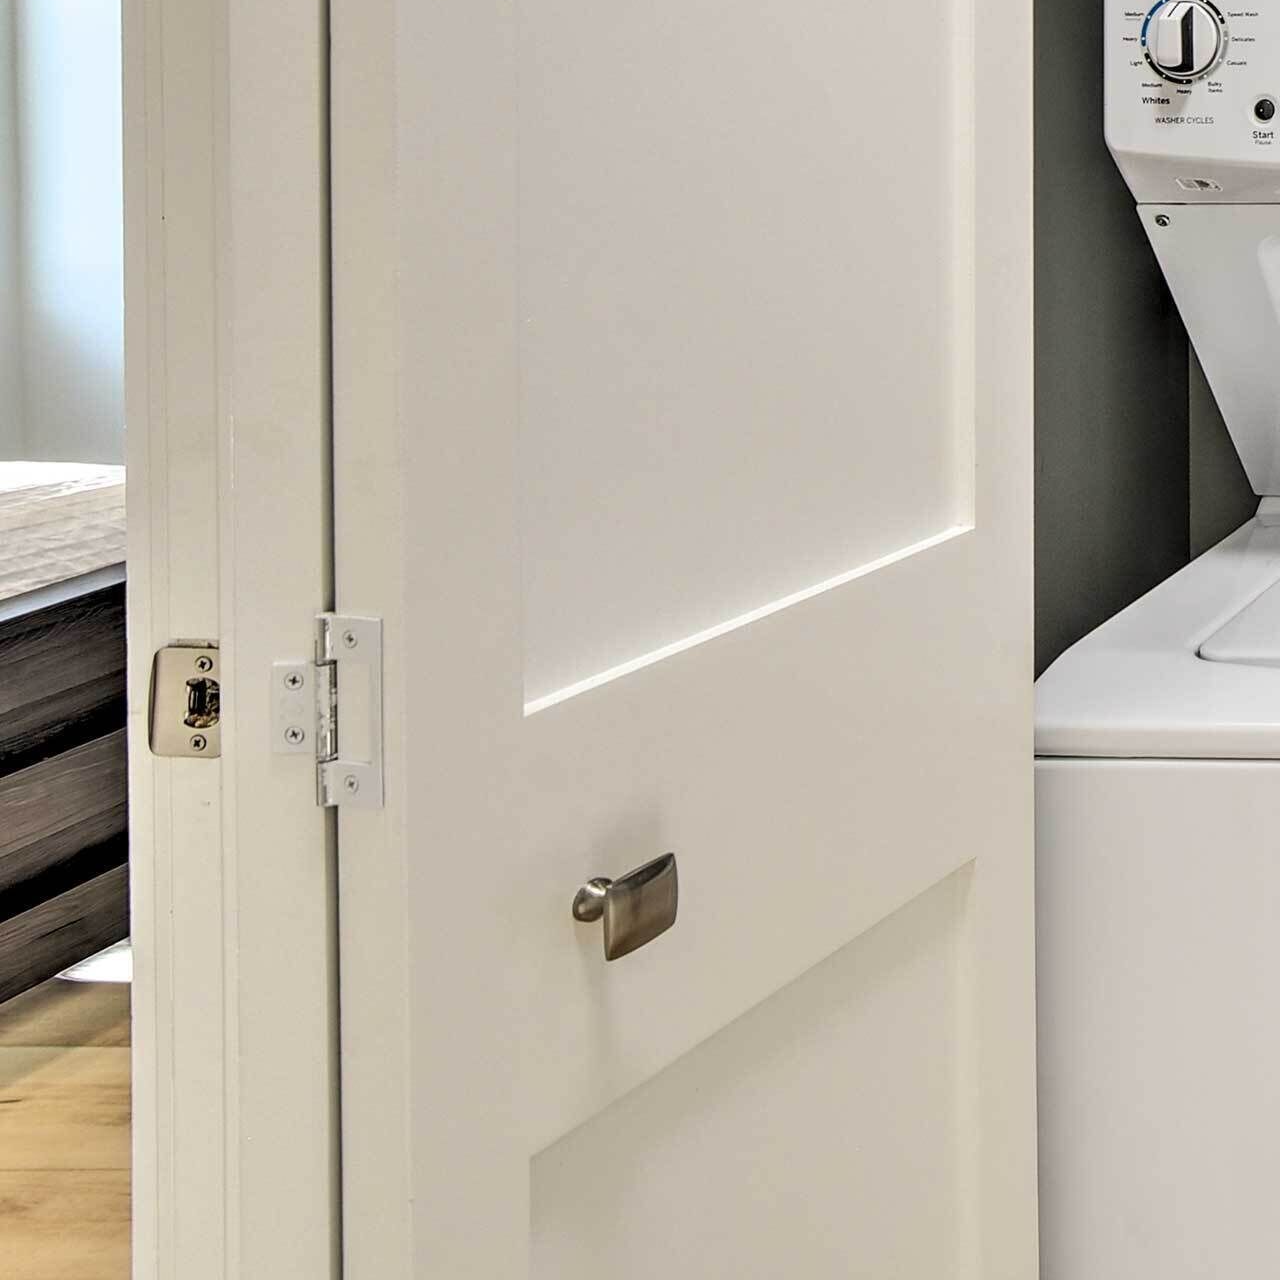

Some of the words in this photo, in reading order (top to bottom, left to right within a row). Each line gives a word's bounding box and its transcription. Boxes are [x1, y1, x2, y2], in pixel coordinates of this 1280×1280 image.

[1142, 96, 1170, 105] Whites
[1155, 116, 1184, 124] WASHER
[1186, 116, 1214, 124] CYCLES
[1252, 131, 1274, 140] Start
